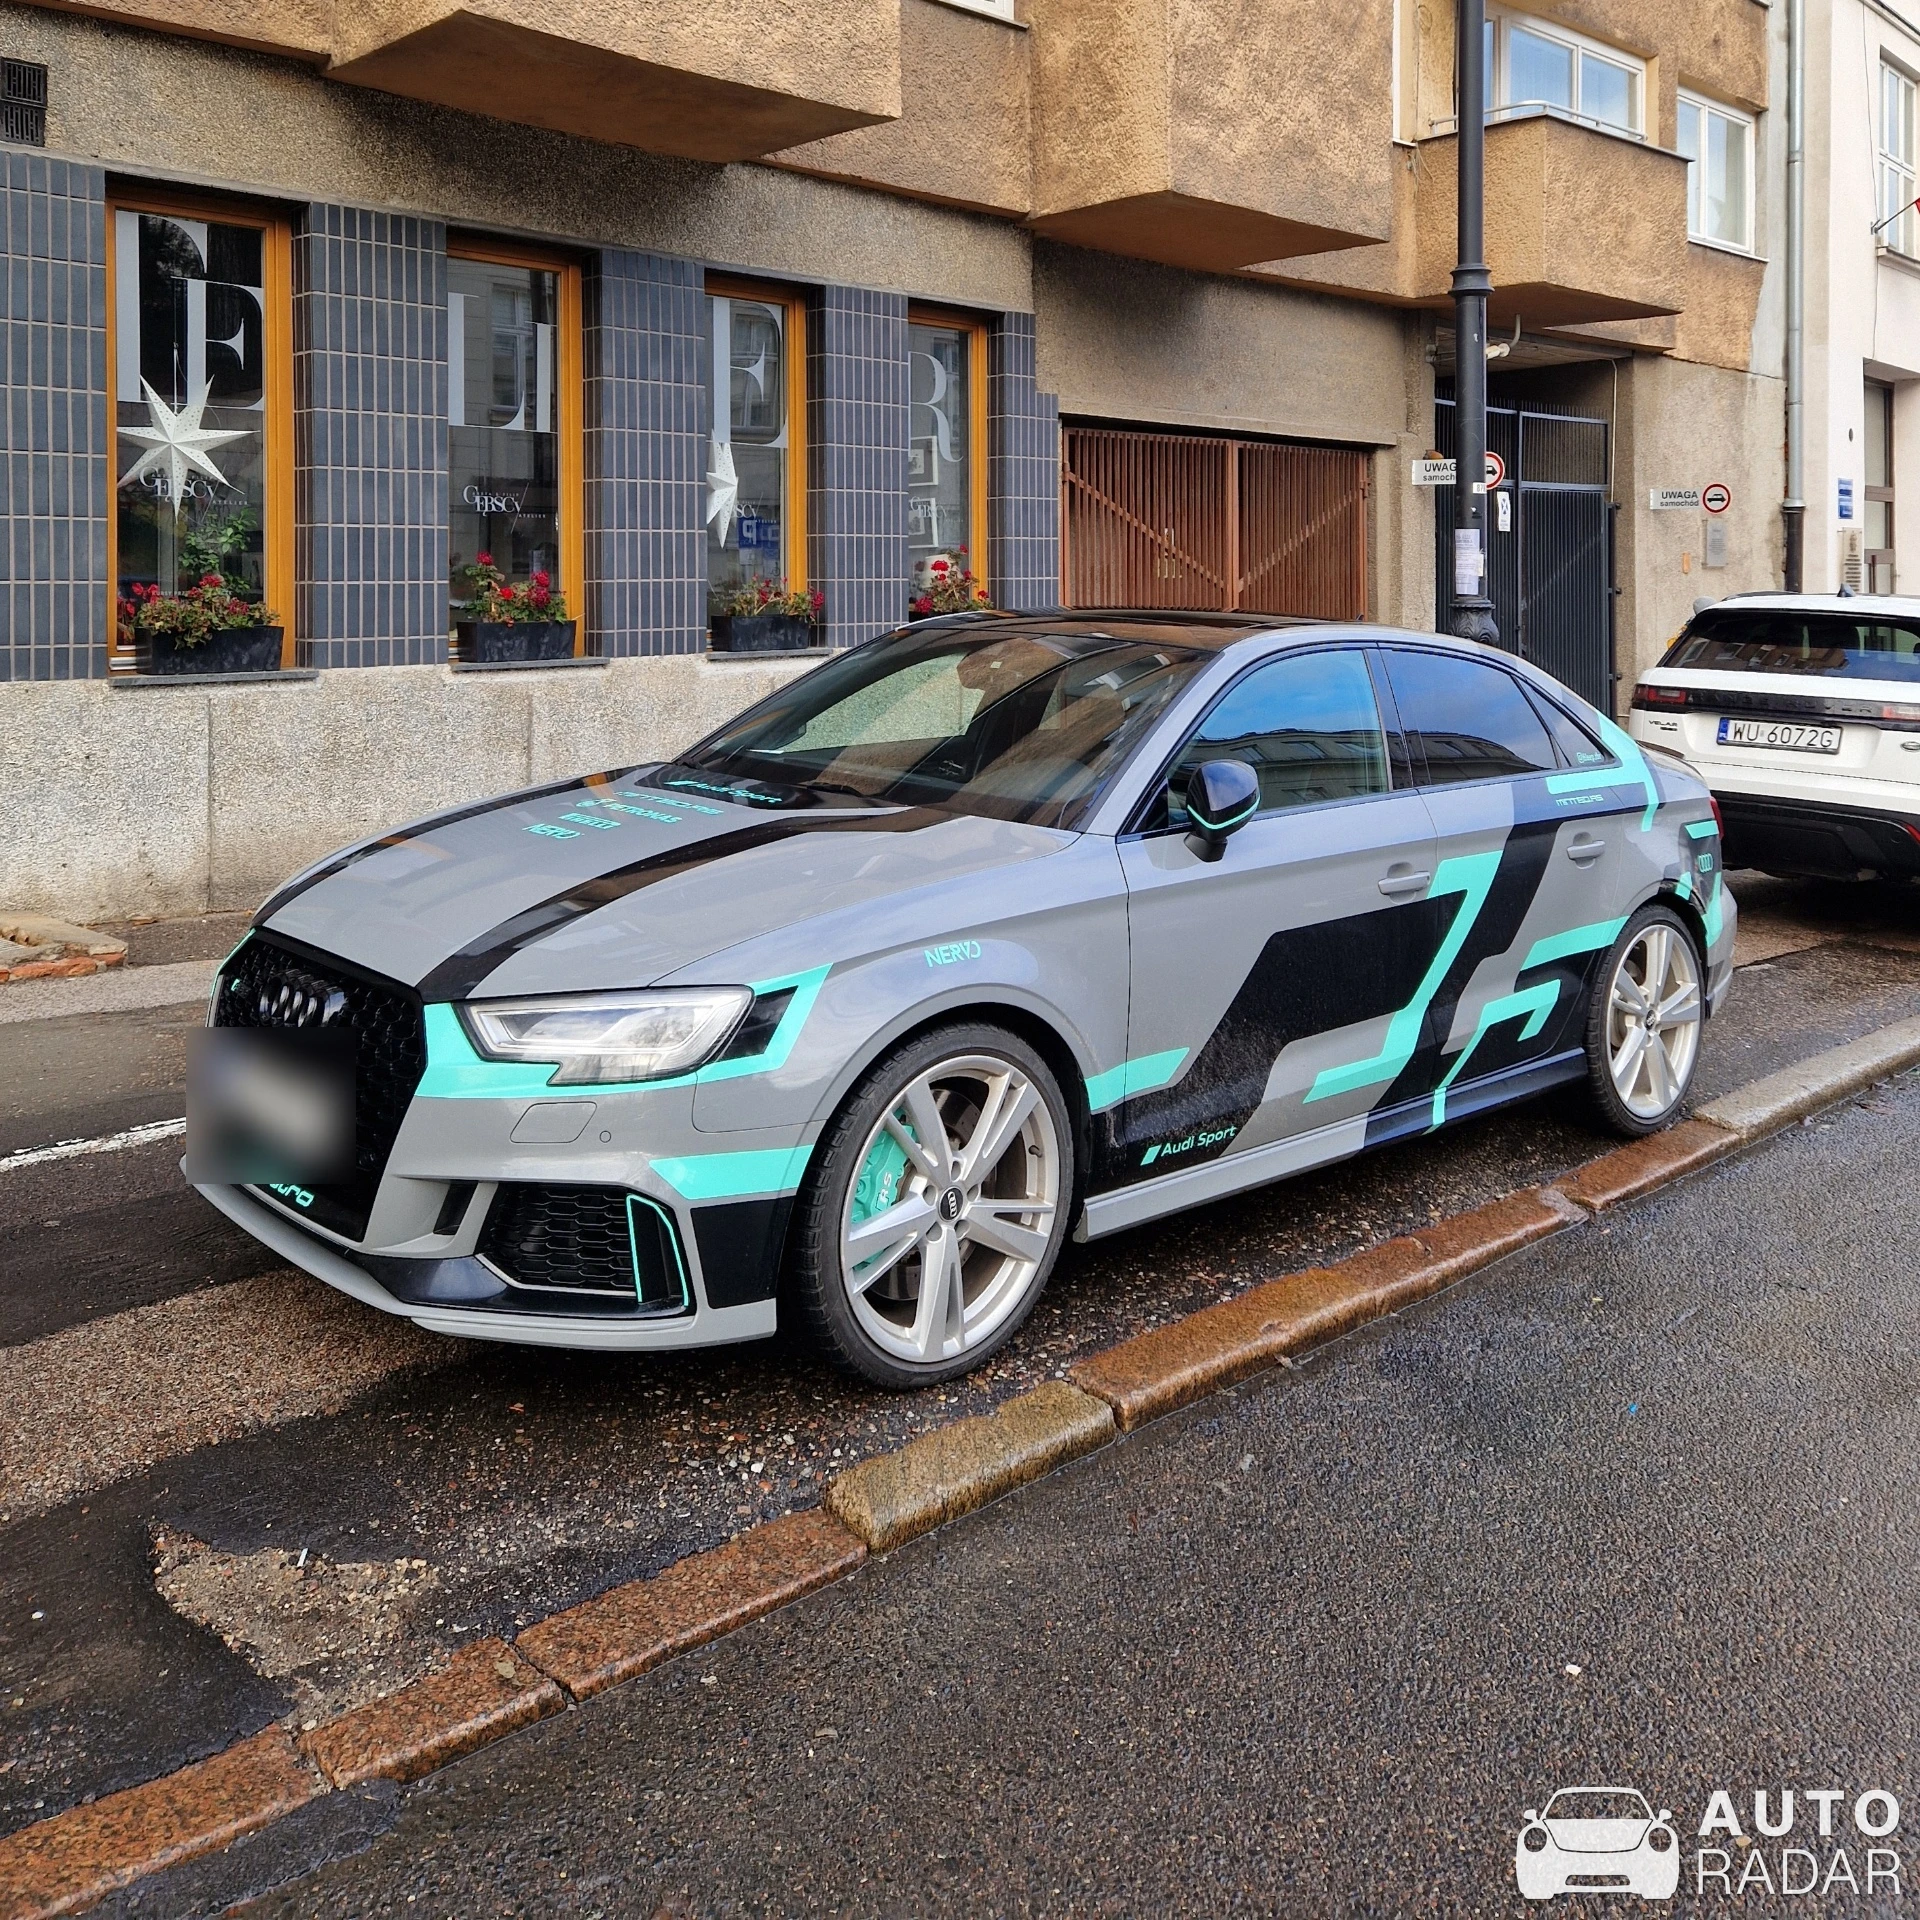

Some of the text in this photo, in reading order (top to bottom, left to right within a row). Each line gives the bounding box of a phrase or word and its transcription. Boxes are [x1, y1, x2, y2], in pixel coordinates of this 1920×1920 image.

[1422, 473, 1456, 482] samoch
[1424, 462, 1456, 472] UWAG
[1661, 491, 1698, 499] UWAGA
[1733, 722, 1833, 748] WU 6072G
[603, 802, 683, 824] PETRONAS
[1161, 1125, 1239, 1157] Audi Sport
[879, 1171, 892, 1204] RS
